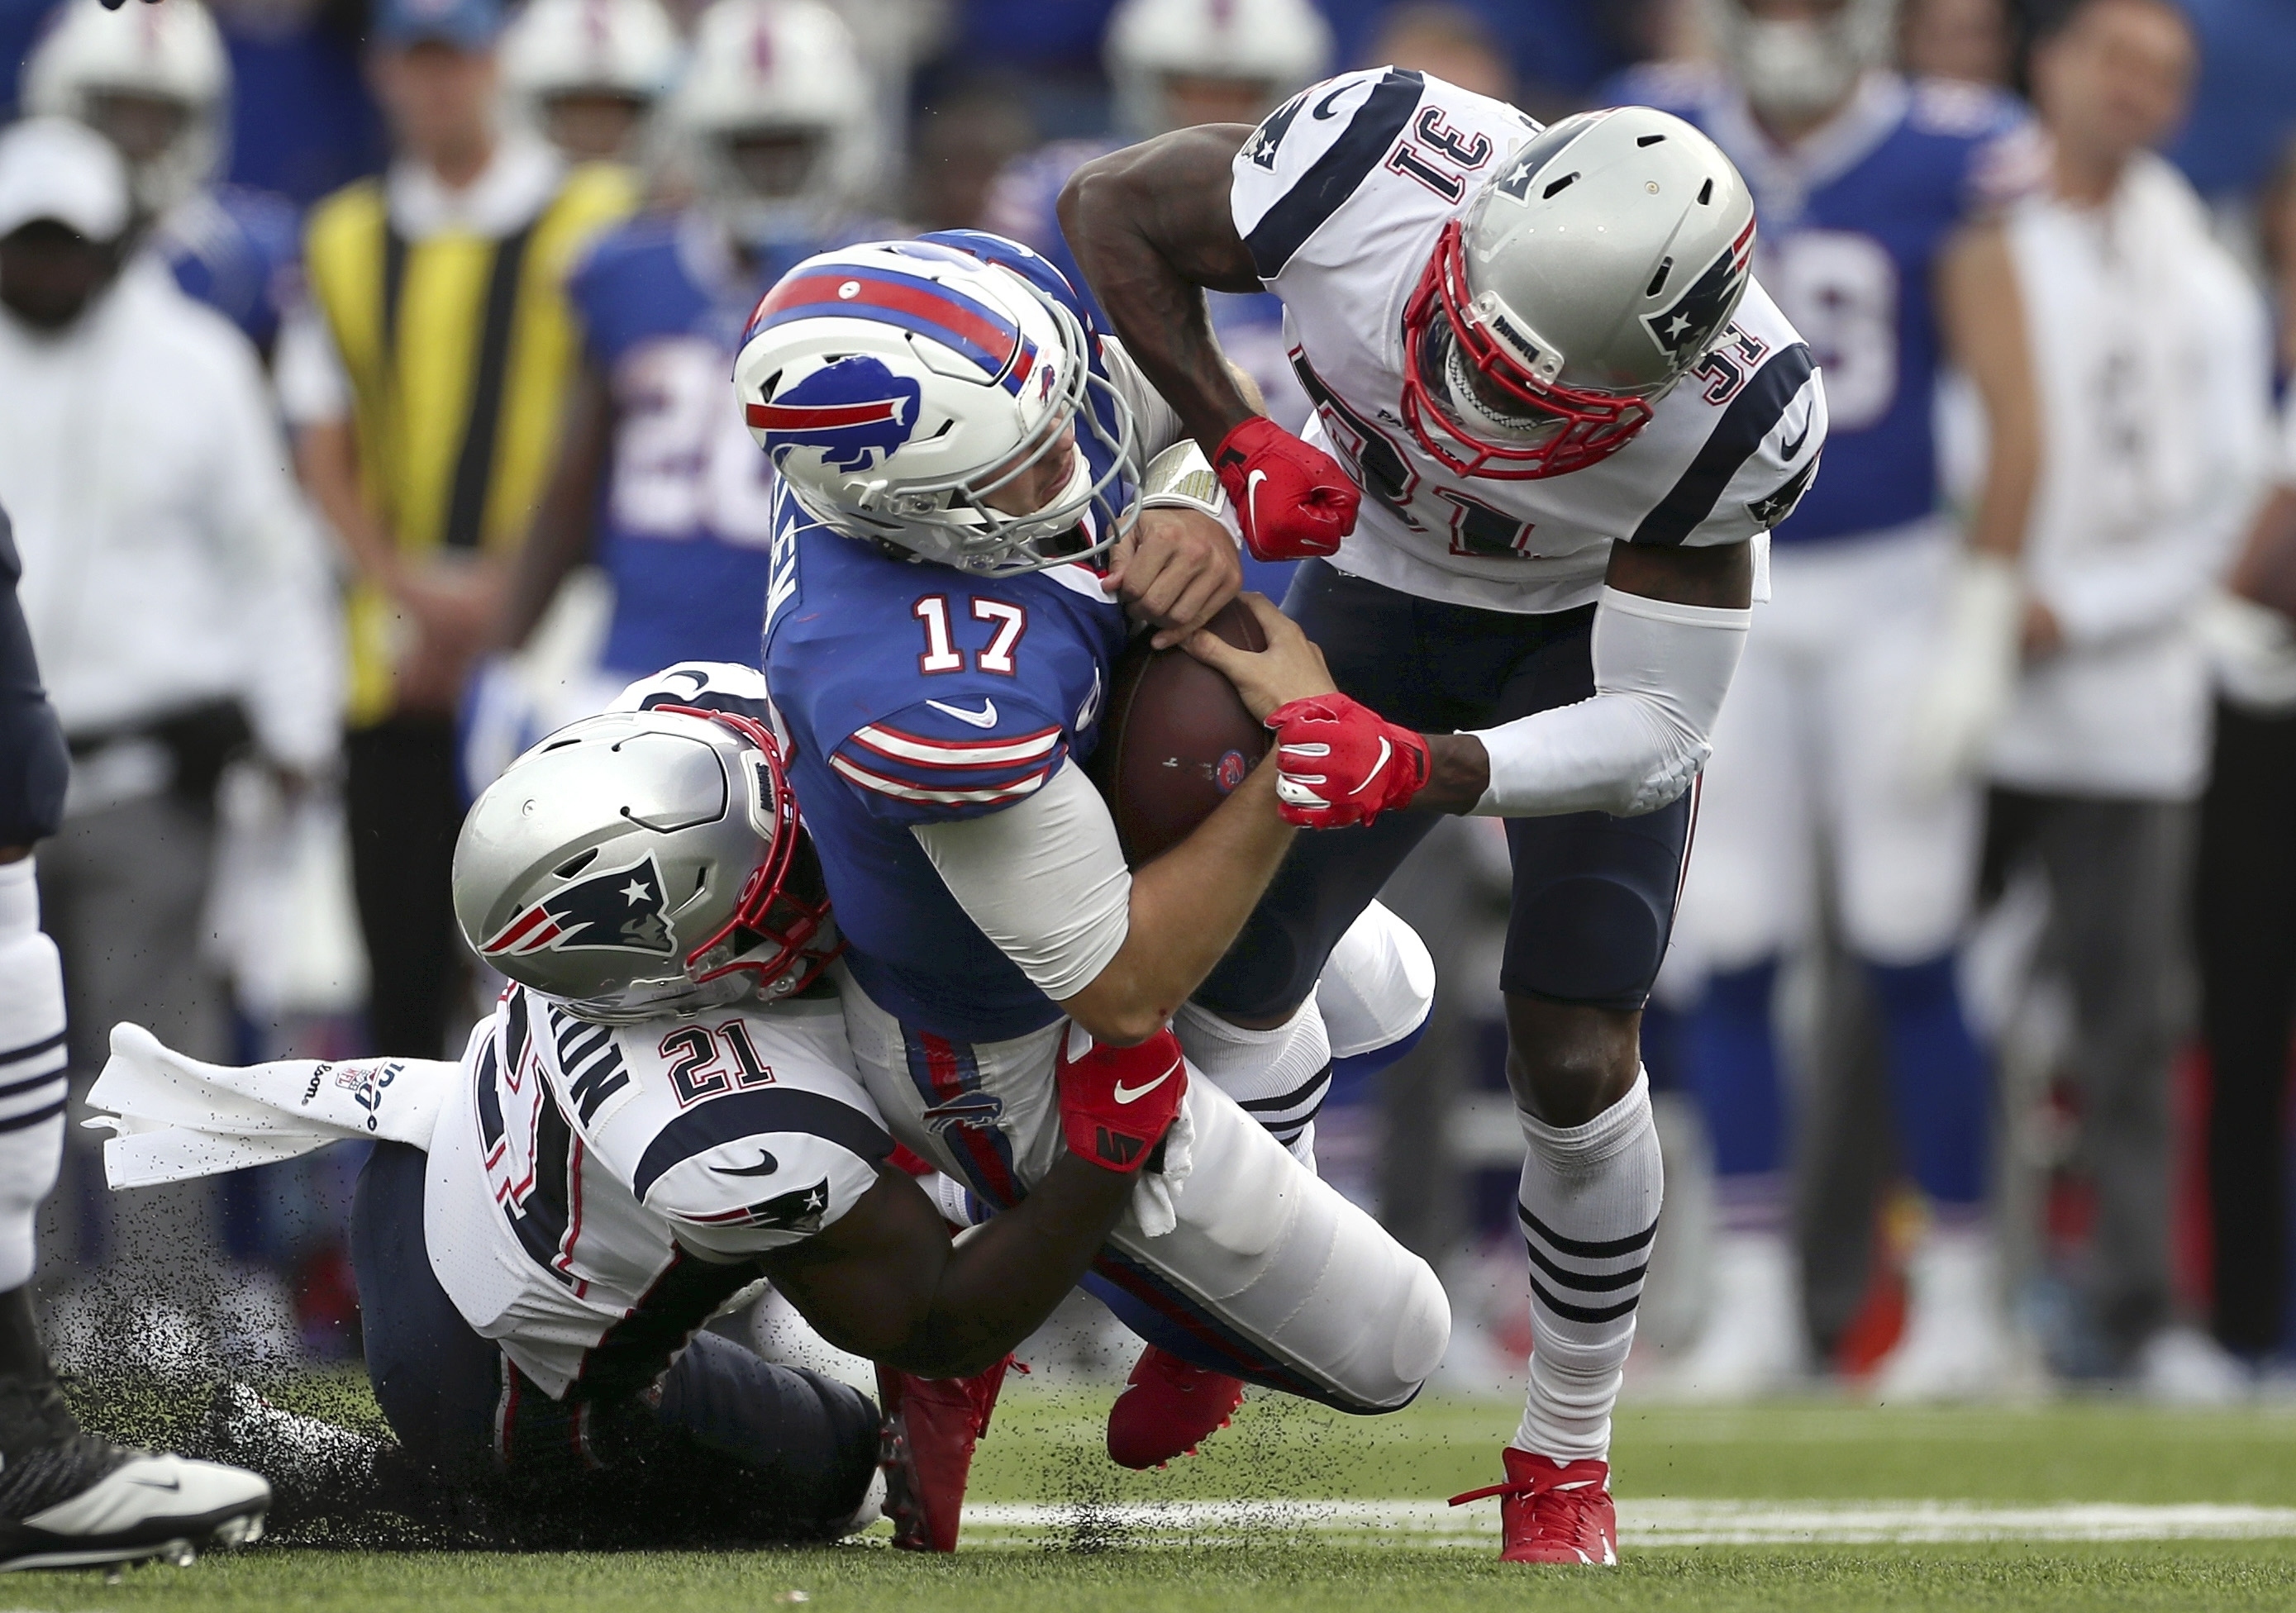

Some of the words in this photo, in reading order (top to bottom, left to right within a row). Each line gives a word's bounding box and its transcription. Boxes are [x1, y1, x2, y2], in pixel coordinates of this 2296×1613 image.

[1384, 105, 1493, 206] 31
[913, 593, 1027, 677] 17
[548, 1002, 631, 1129] ON
[659, 1018, 777, 1109] 21
